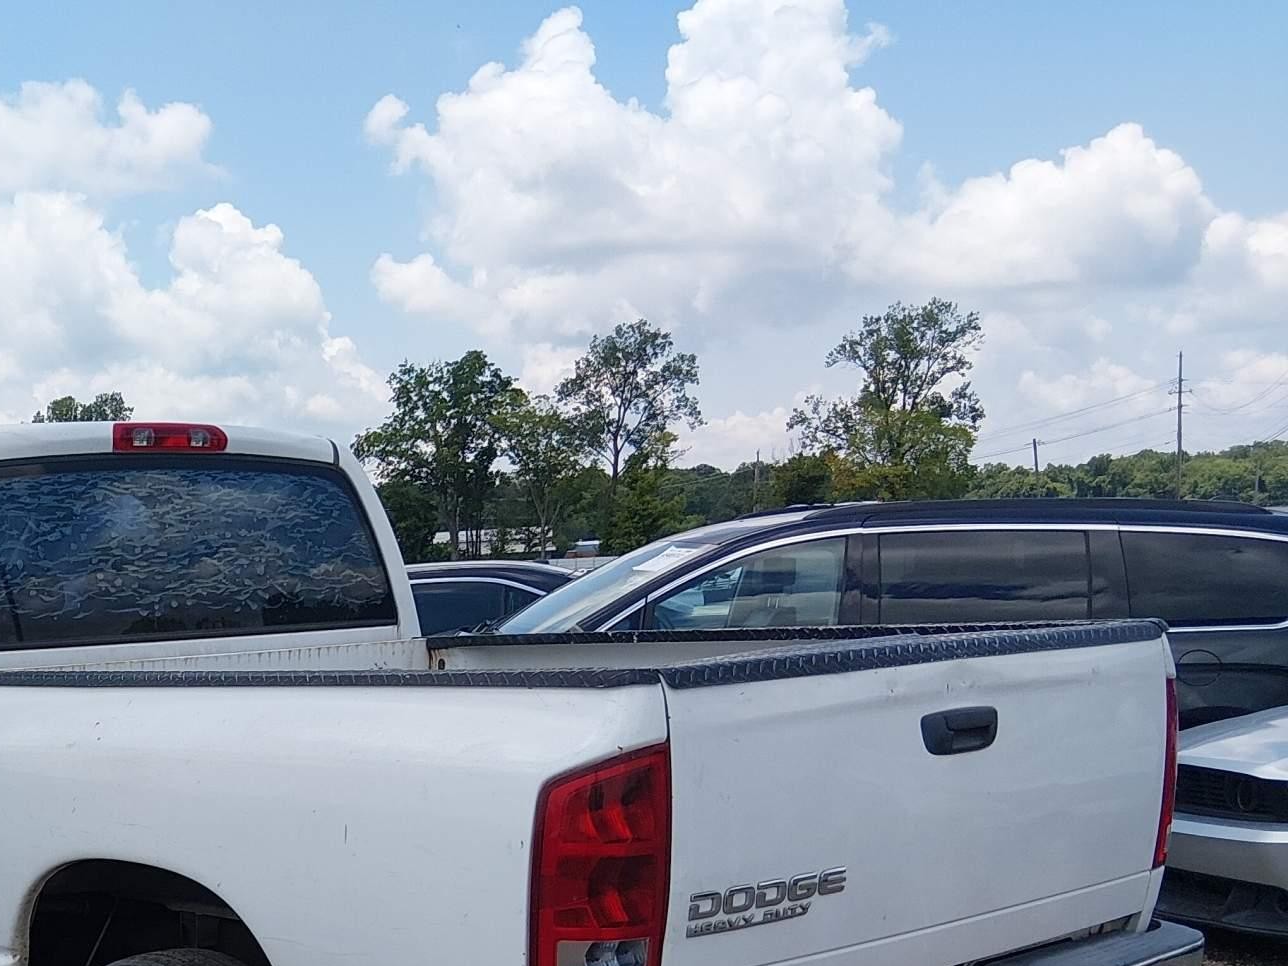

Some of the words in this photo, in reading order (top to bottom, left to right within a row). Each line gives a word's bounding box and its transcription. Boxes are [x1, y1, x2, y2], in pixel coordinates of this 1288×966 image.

[688, 865, 847, 921] DODGE
[686, 913, 755, 938] HEAVY
[762, 901, 812, 925] DUTY
